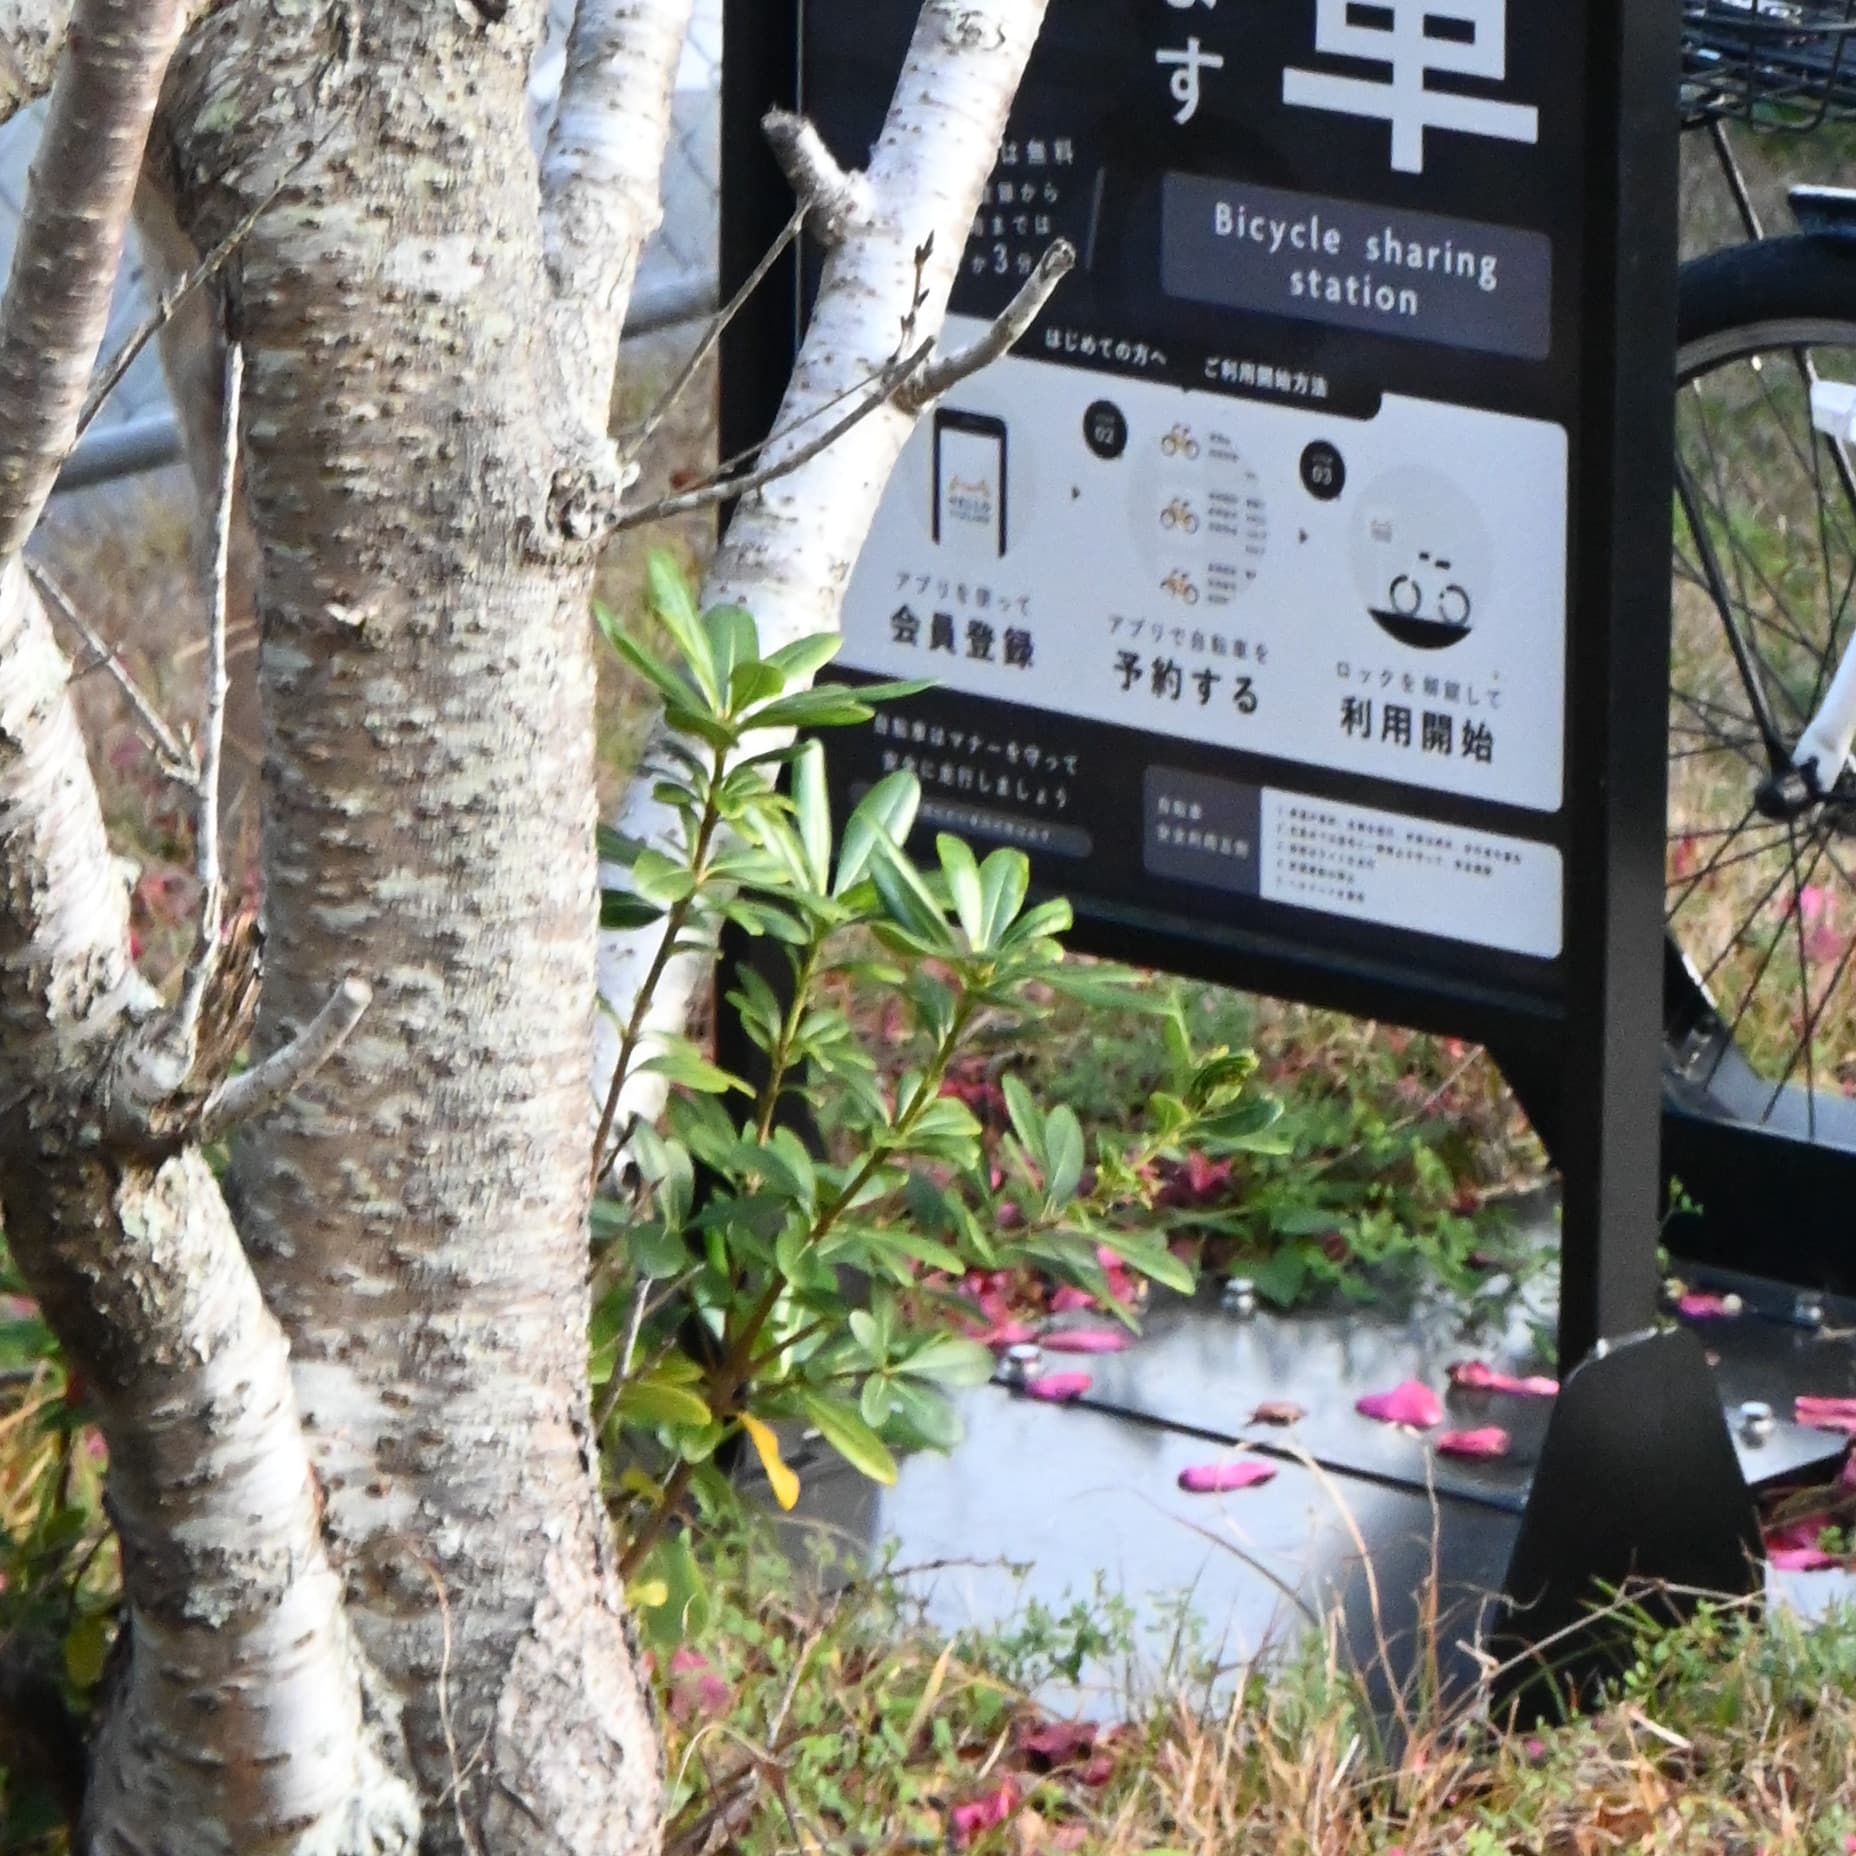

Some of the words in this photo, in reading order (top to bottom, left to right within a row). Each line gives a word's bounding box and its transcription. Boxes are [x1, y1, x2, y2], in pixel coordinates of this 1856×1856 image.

[1214, 200, 1342, 254] Bicycle
[1366, 226, 1498, 292] sharing
[1290, 268, 1418, 317] station
[1044, 327, 1168, 366] はじめての方へ
[890, 604, 1034, 670] 会員登録
[1113, 649, 1259, 715] 予約する
[1340, 694, 1495, 765] 利用開始
